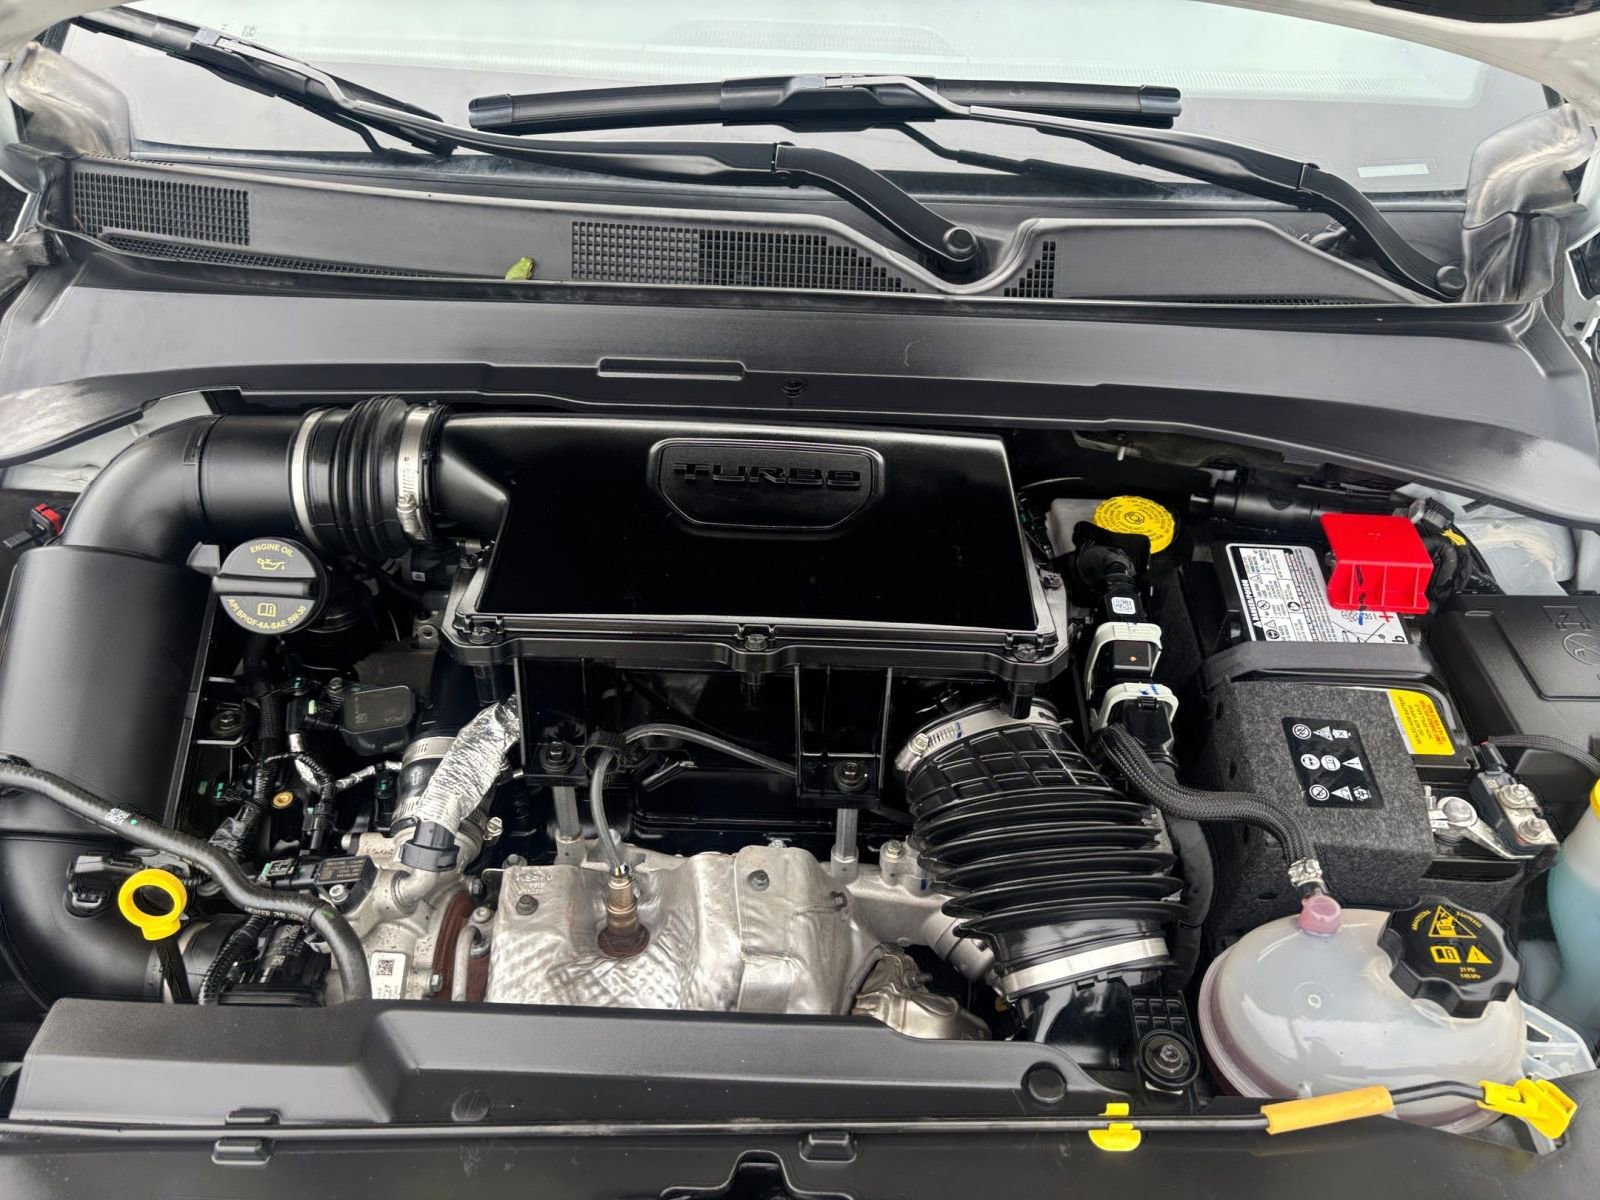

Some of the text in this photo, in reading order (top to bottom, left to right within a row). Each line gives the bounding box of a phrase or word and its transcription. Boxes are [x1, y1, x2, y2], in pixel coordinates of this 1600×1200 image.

[672, 462, 861, 487] TURBO
[249, 543, 294, 558] ENGINE OIL
[228, 598, 238, 612] API
